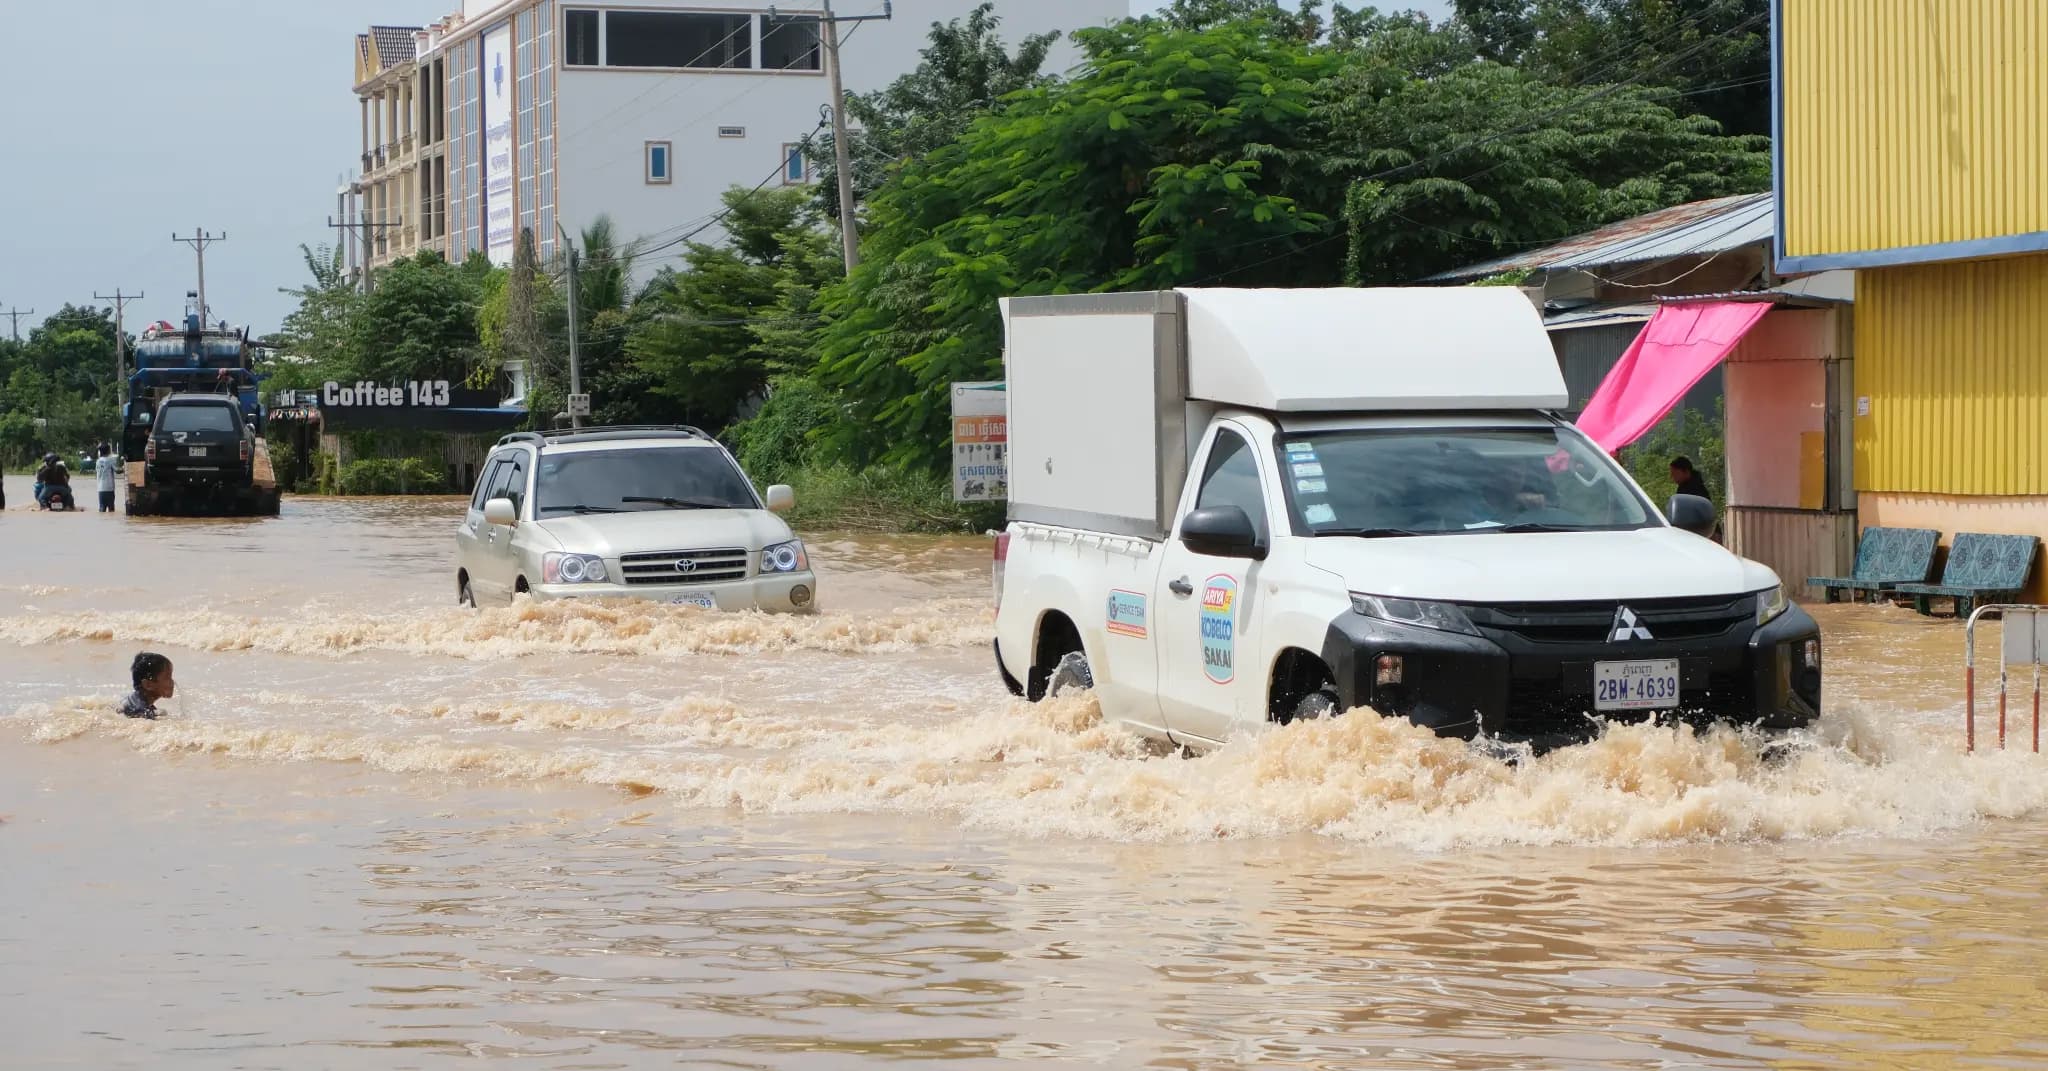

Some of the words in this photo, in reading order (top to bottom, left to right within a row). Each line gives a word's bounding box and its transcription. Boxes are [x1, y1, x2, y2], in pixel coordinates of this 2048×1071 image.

[323, 380, 404, 407] Coffee
[408, 379, 450, 407] 143
[1204, 589, 1225, 605] ARIYA
[1201, 616, 1233, 640] KOBELCO
[1204, 646, 1231, 668] SAKAI
[1599, 677, 1675, 700] 2BM-4639
